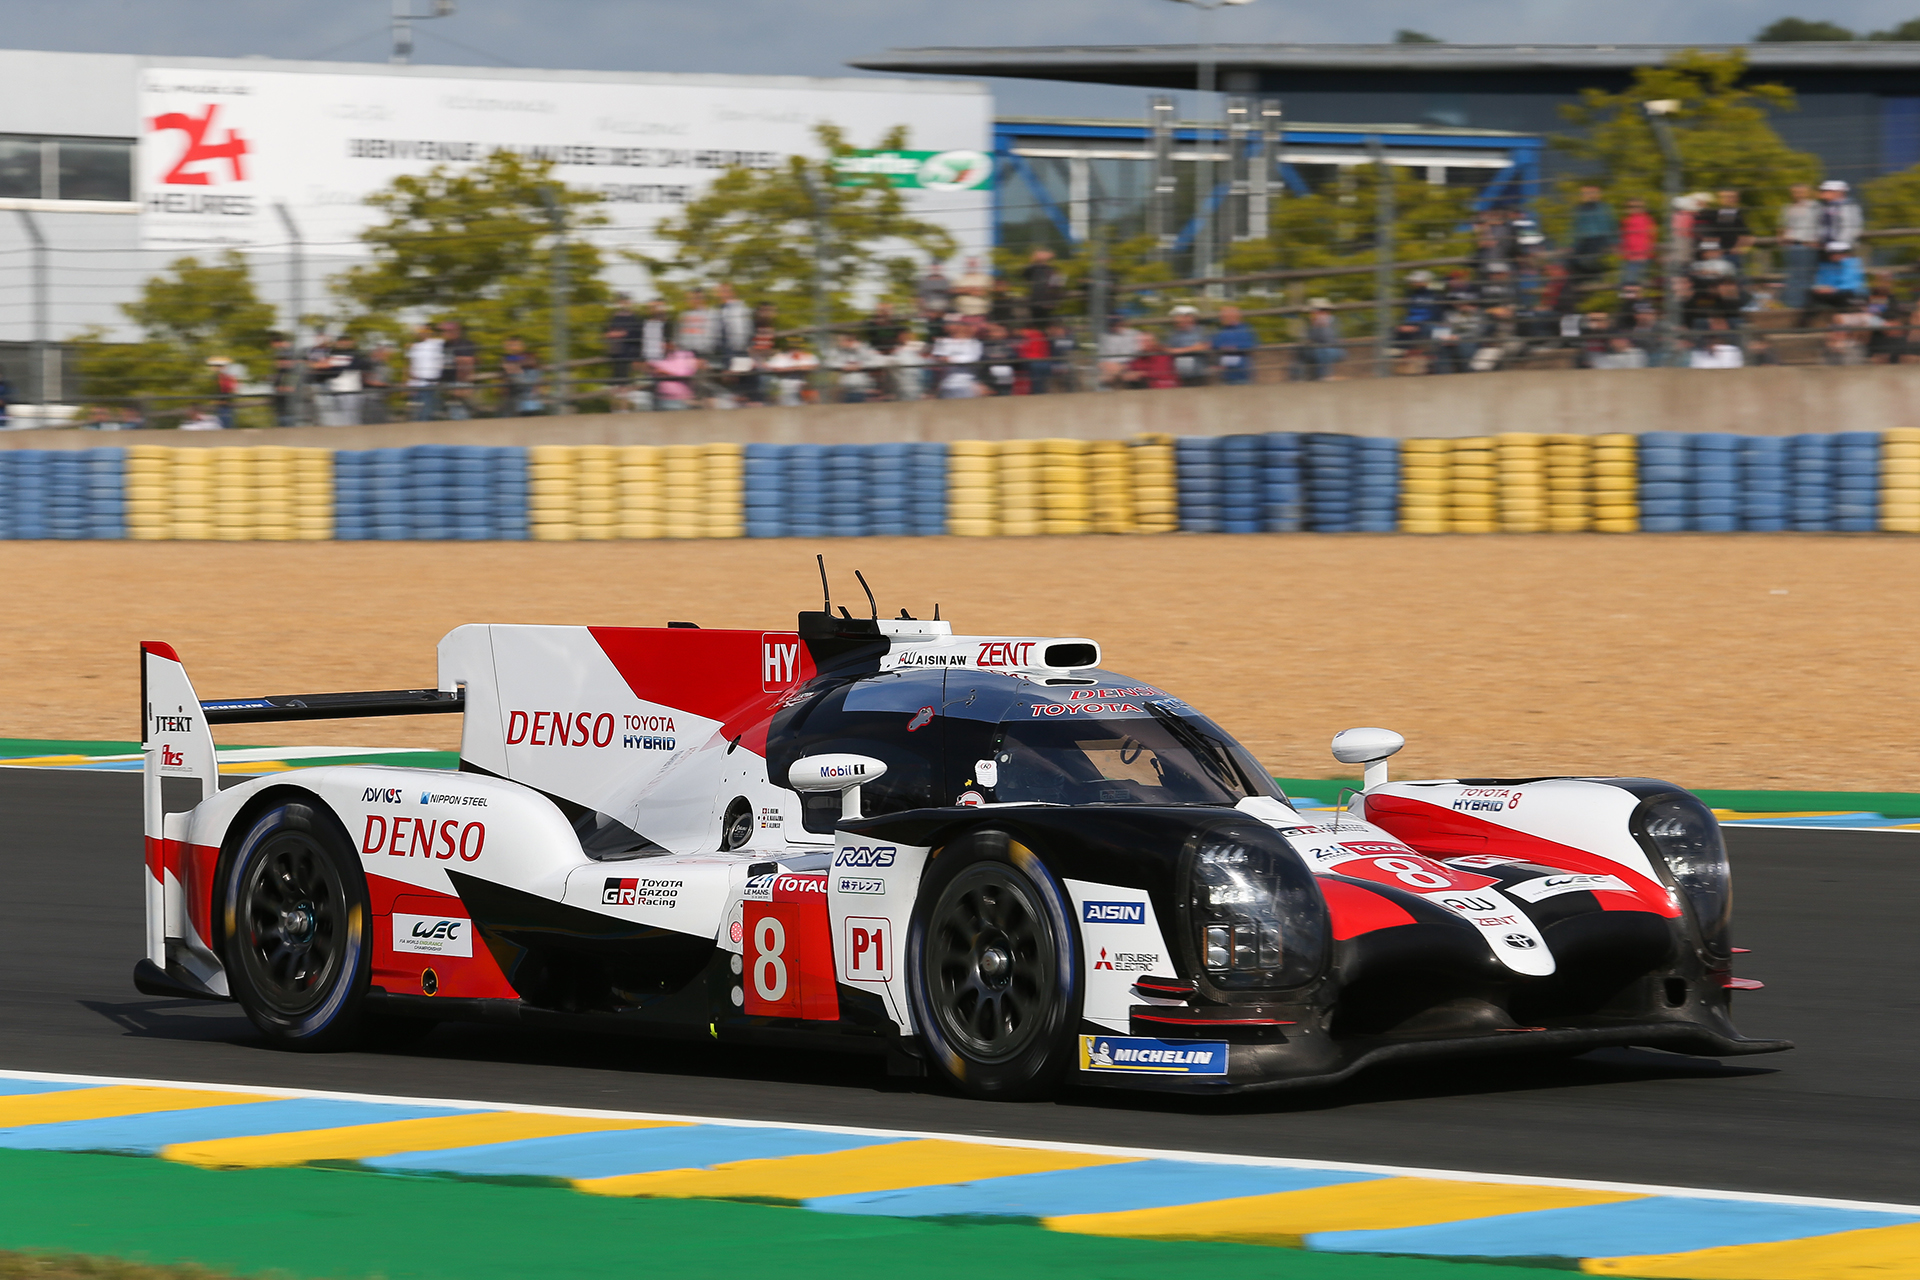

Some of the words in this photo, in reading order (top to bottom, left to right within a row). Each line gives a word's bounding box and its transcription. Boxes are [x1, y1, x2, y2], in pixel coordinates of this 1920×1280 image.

[146, 104, 257, 185] 24
[764, 643, 797, 683] HY
[915, 655, 947, 665] AISIN
[949, 655, 967, 666] AW
[976, 642, 1037, 667] ZENT
[1031, 703, 1145, 717] TOYOTA
[155, 715, 193, 735] JTEKT
[506, 710, 615, 748] DENSO
[623, 714, 676, 733] TOYOTA
[623, 734, 676, 751] HYBRID
[820, 764, 852, 778] Mobil
[854, 763, 865, 775] 1
[361, 787, 403, 804] ADVICS
[430, 794, 461, 805] NIPPON
[461, 798, 489, 807] STEEL
[1460, 788, 1510, 798] TOYOTA
[1508, 792, 1523, 809] 8
[1453, 799, 1504, 812] HYBRID
[361, 814, 486, 862] DENSO
[835, 847, 897, 867] RAYS
[1374, 857, 1452, 888] 8
[641, 878, 683, 888] TOYOTA
[778, 876, 828, 894] TOTAL
[603, 889, 636, 904] GR
[639, 887, 678, 897] GAZOO
[637, 897, 676, 909] Racing
[1086, 905, 1141, 921] AISIN
[1474, 915, 1519, 927] ZENT
[411, 920, 462, 941] WEC
[852, 927, 884, 972] P1
[1115, 953, 1159, 963] MITSUBISHI
[753, 916, 788, 1002] 8
[1115, 963, 1154, 972] ELECTRIC
[1114, 1048, 1214, 1065] MICHELIN
